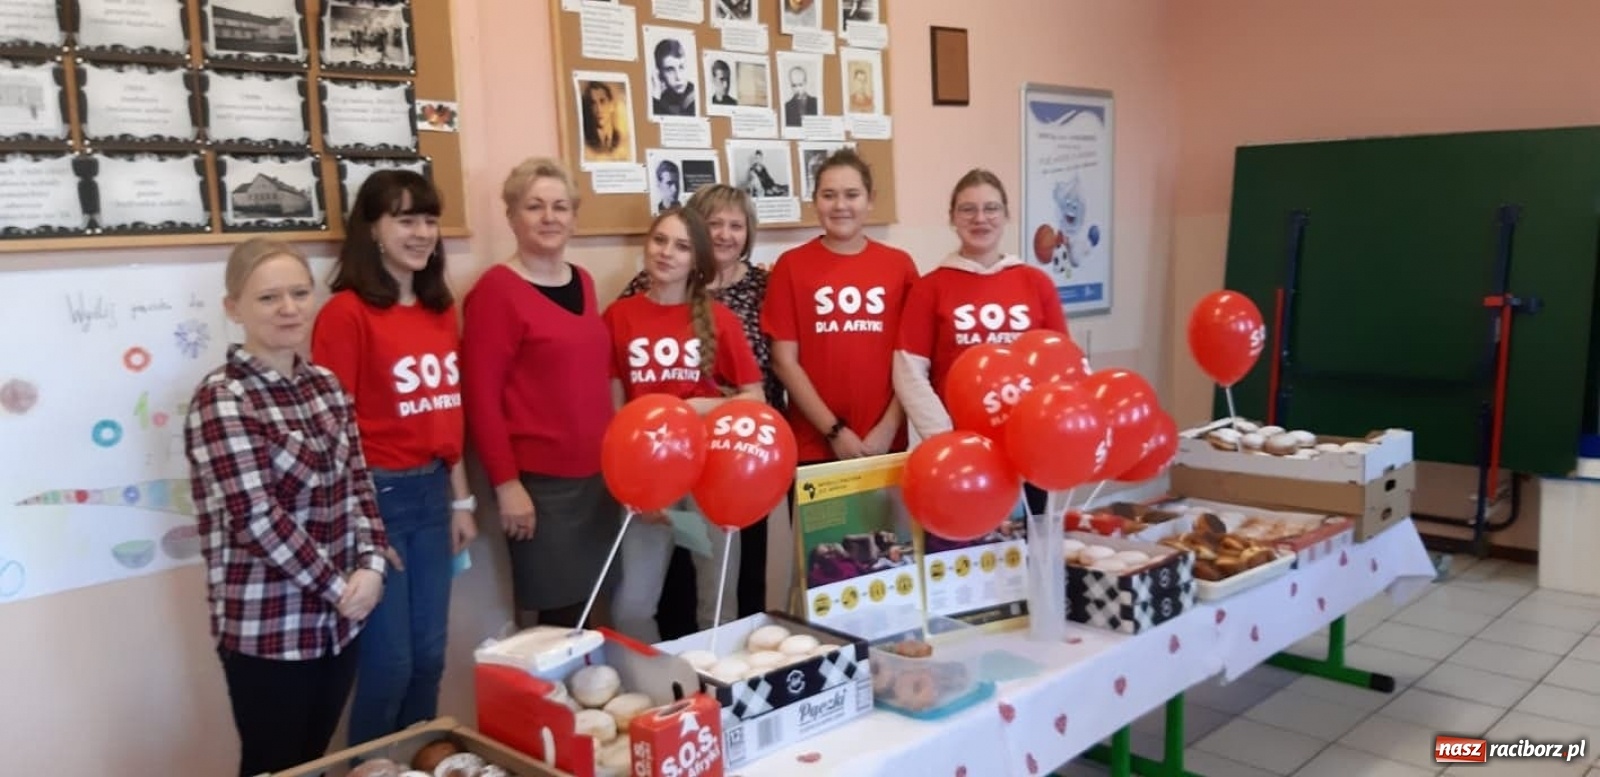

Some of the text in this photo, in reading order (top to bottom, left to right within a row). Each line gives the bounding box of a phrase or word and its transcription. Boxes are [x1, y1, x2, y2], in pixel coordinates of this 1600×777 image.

[814, 286, 886, 315] SOS
[815, 319, 883, 333] DLA AFRYKI
[953, 303, 1031, 331] SOS
[628, 337, 701, 367] SOS
[393, 351, 460, 394] SOS
[399, 397, 433, 417] DLA
[713, 415, 777, 446] SOS
